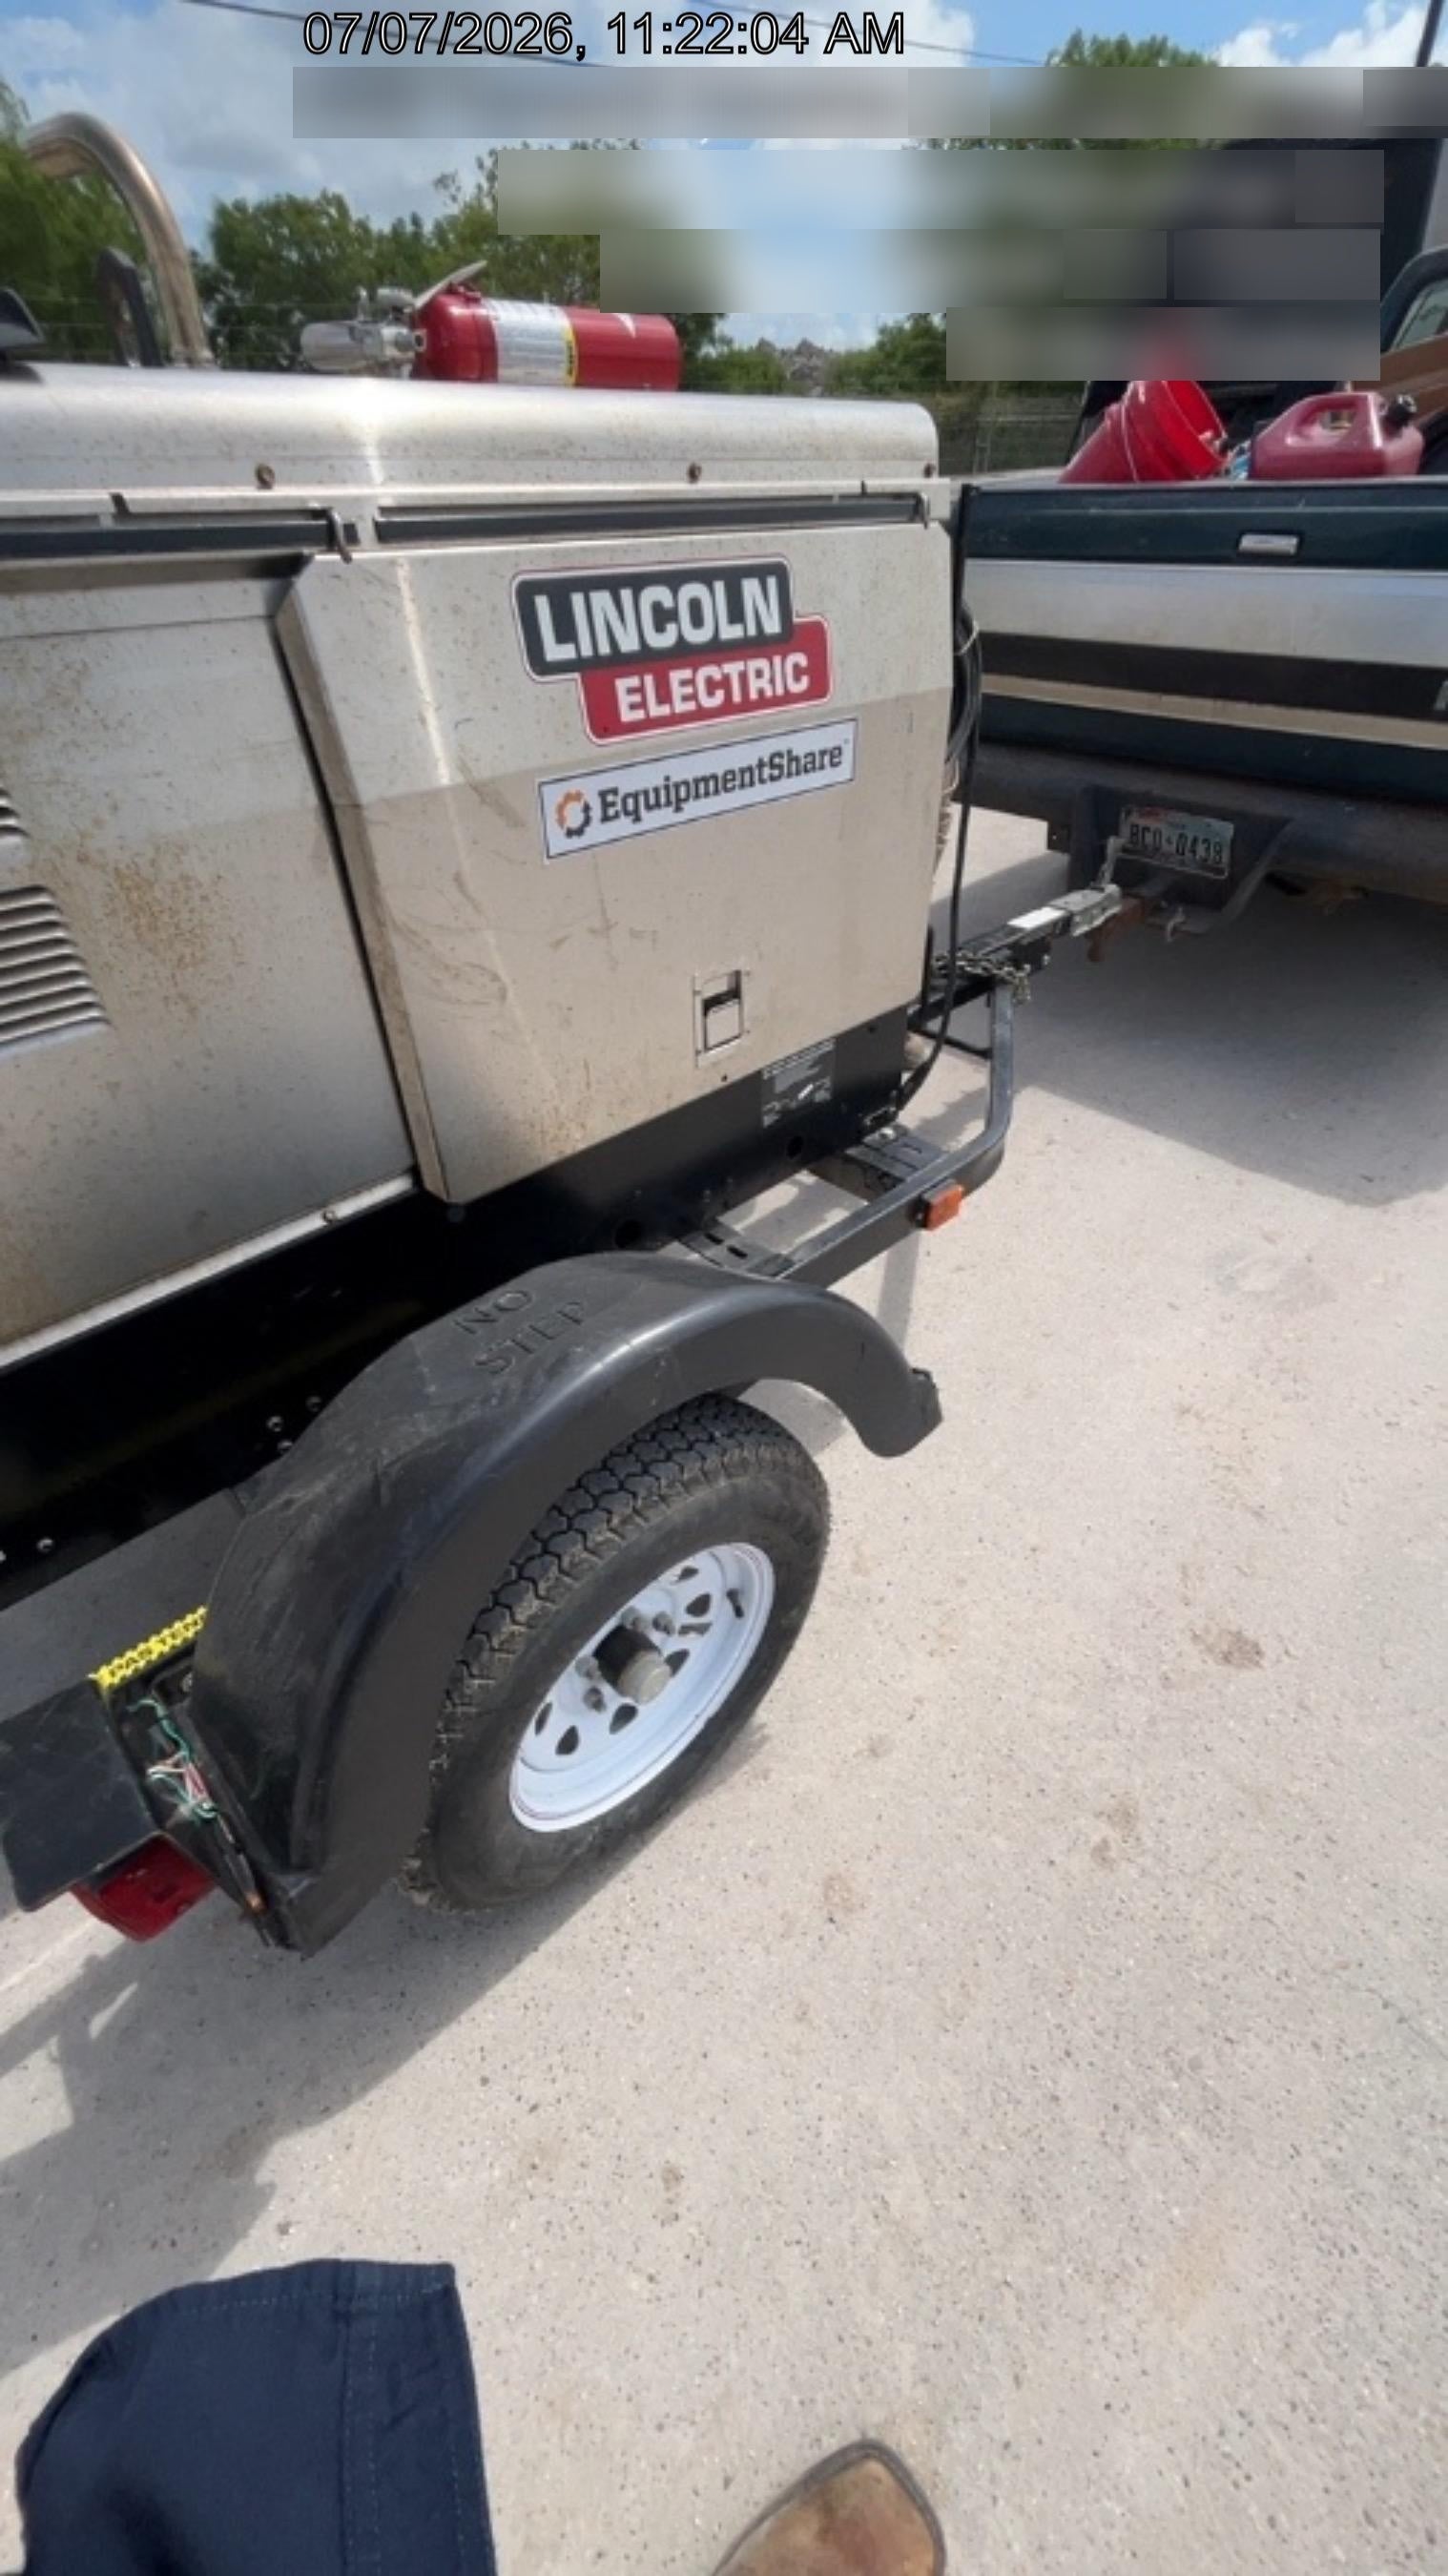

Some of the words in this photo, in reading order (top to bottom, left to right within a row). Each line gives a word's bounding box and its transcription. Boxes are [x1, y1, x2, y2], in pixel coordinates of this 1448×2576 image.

[533, 574, 782, 663] LINCOLN
[614, 652, 810, 723] ELECTRIC
[598, 744, 843, 825] EquipmentShare
[453, 1290, 533, 1335] NO
[475, 1300, 586, 1376] STEP
